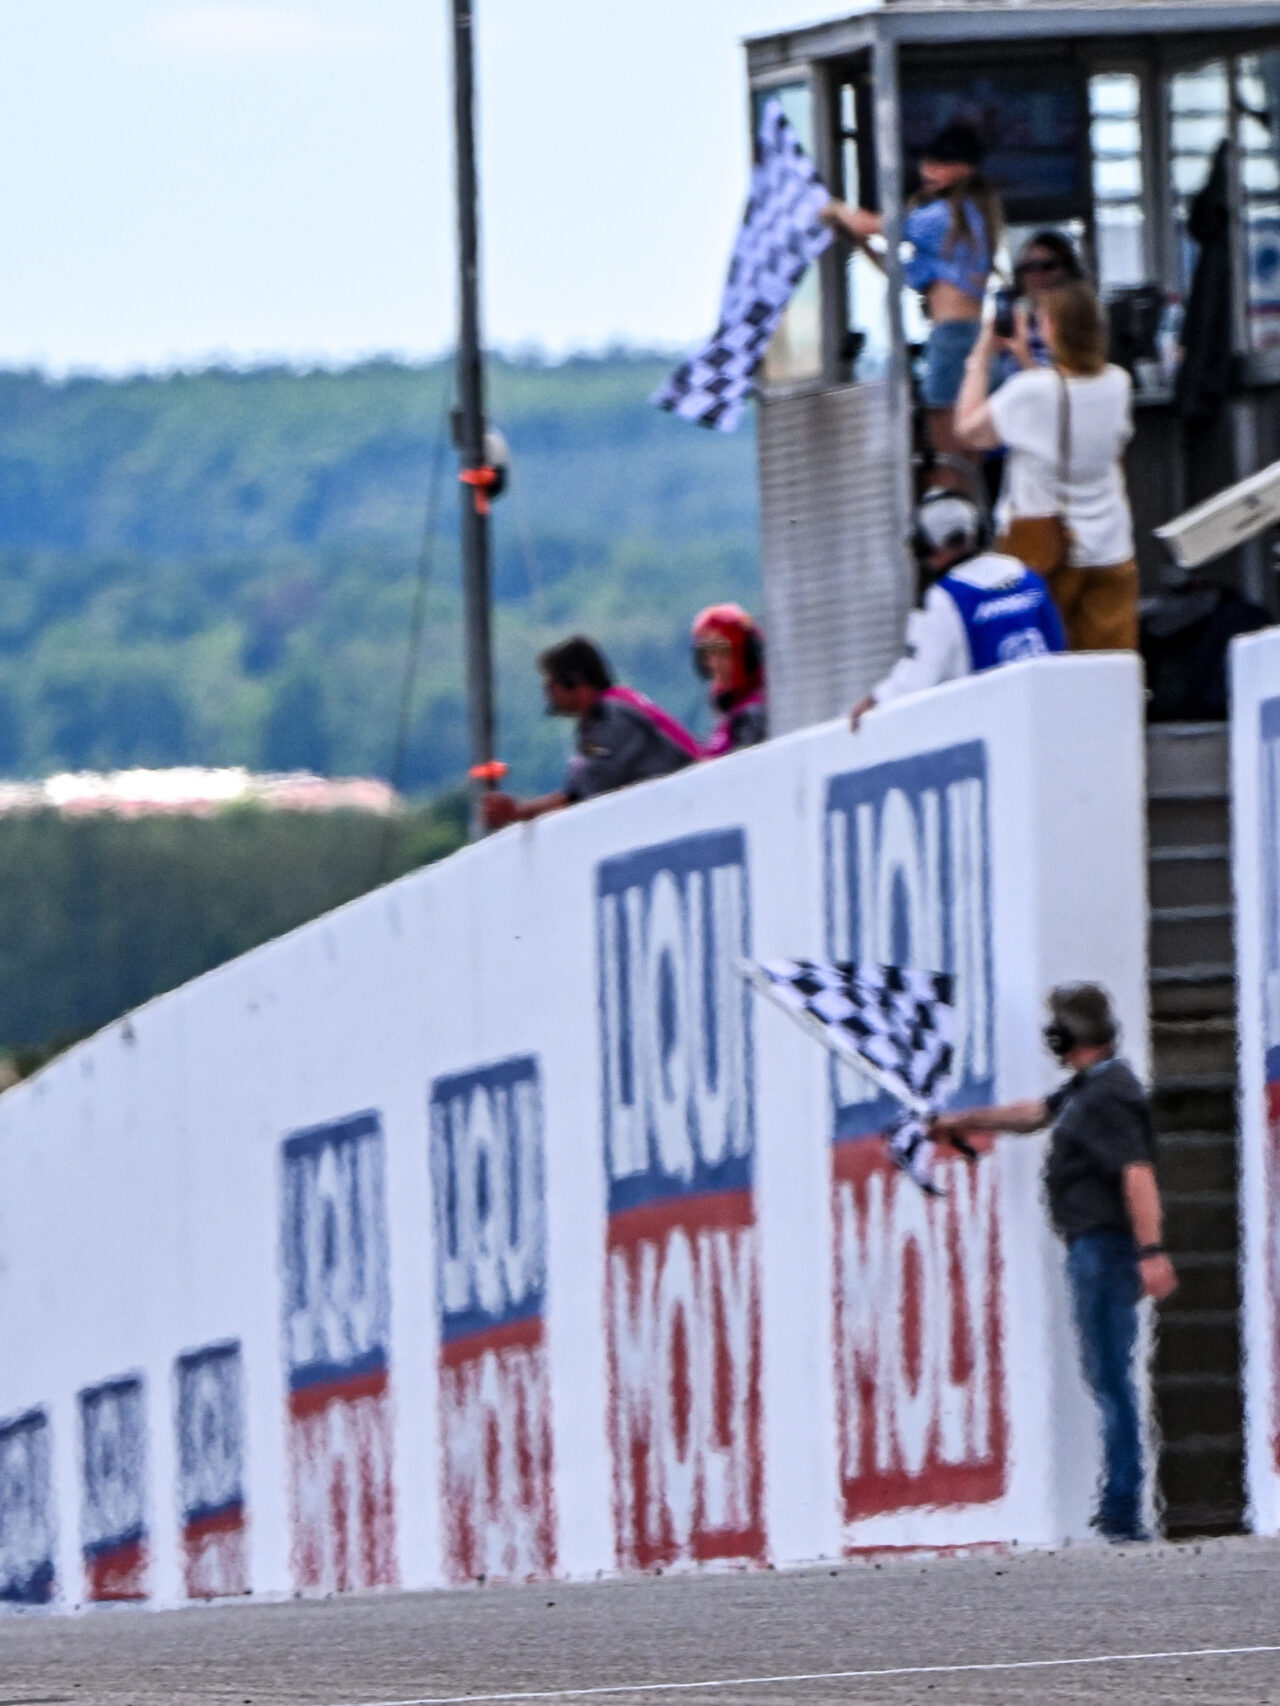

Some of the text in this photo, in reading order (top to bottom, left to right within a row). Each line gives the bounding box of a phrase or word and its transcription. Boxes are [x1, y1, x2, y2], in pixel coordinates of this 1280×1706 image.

[602, 865, 755, 1185] LIQUI
[828, 776, 990, 1112] LIQUI
[432, 1085, 546, 1318] LIQUI
[842, 1160, 1004, 1485] MOLY
[608, 1225, 764, 1560] MOLY
